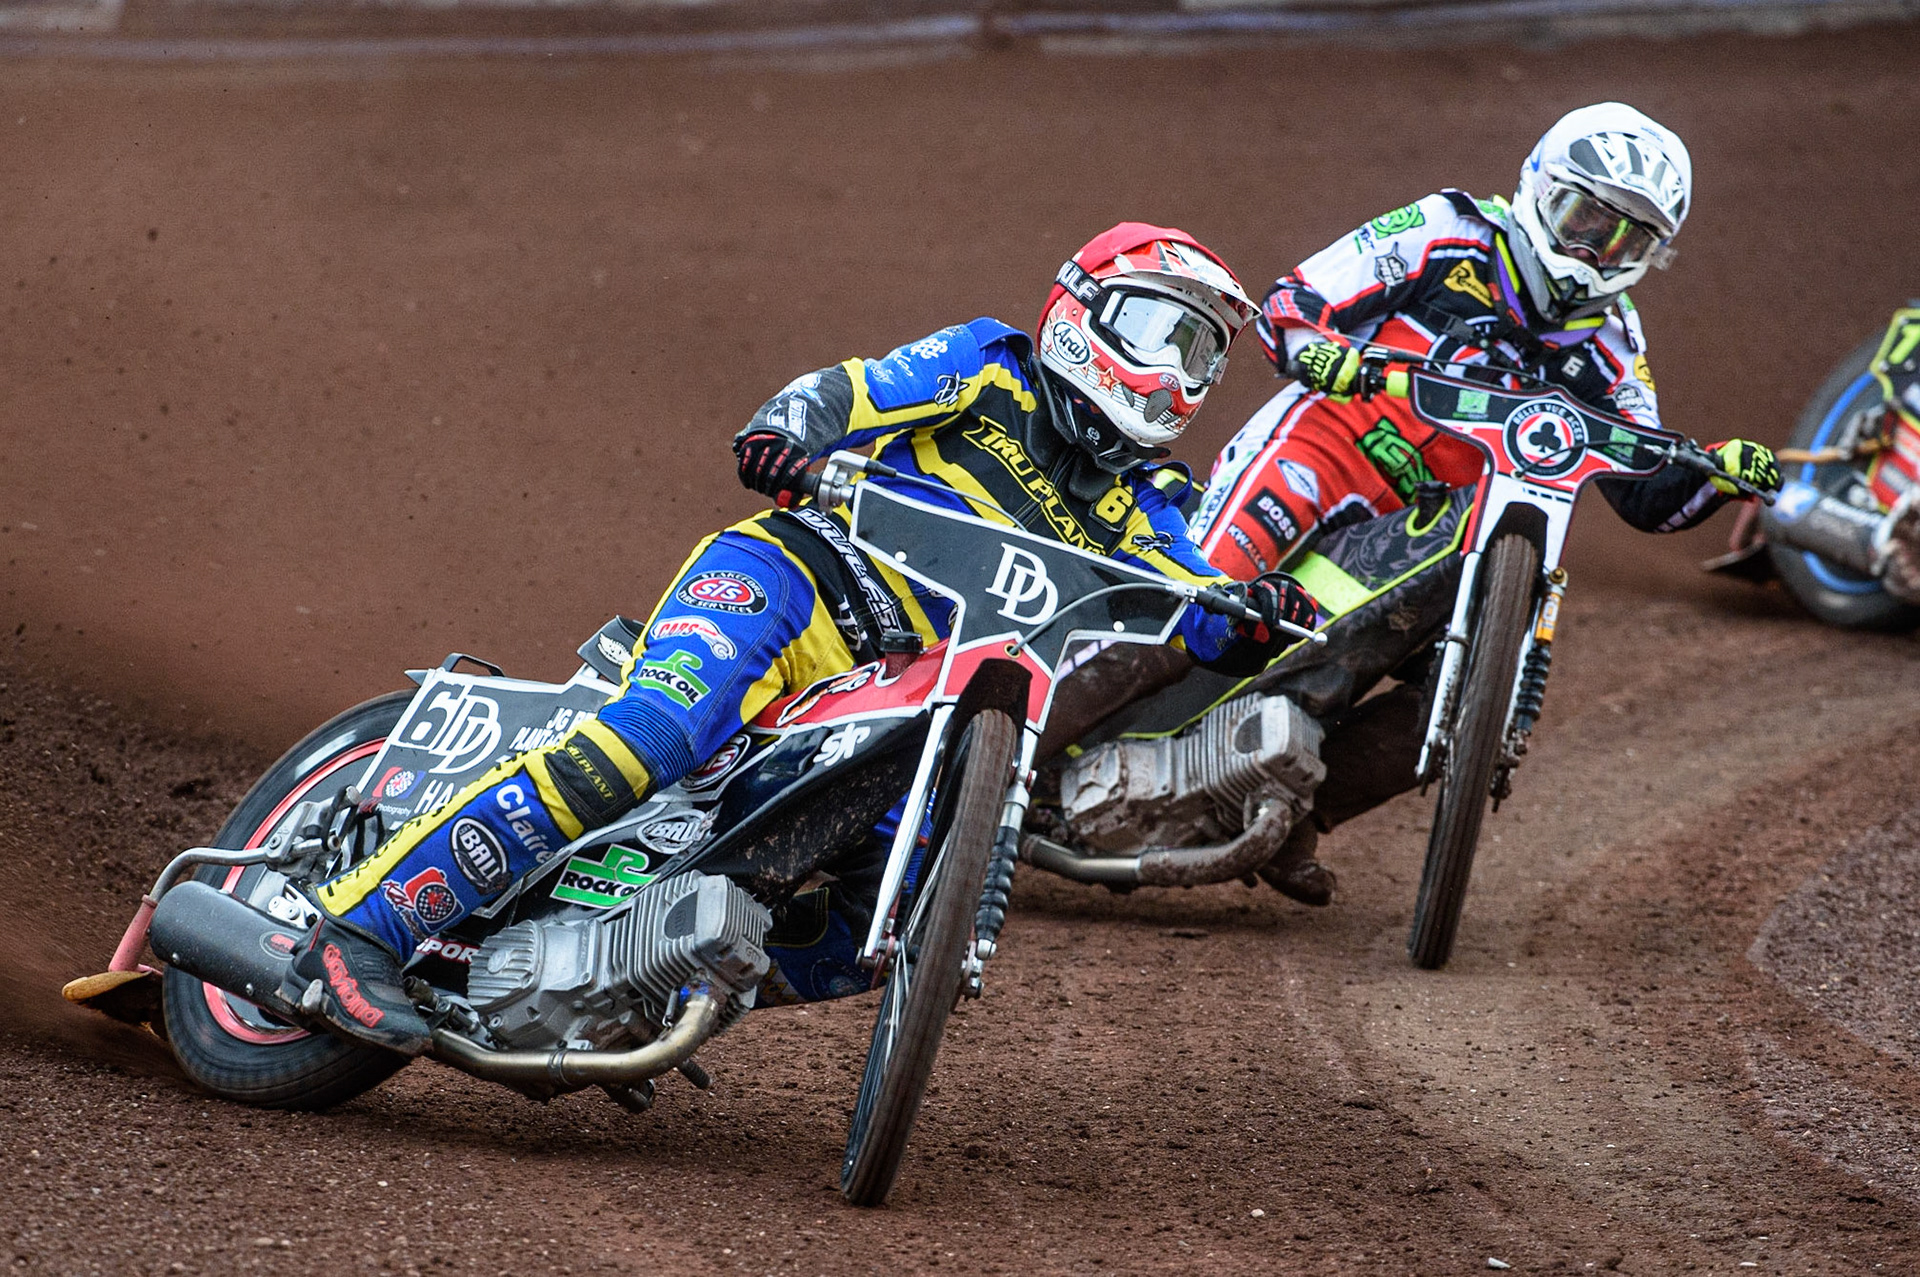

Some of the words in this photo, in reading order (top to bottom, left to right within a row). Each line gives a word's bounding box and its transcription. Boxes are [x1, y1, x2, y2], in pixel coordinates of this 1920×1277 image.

[1054, 328, 1087, 359] Arai
[1513, 403, 1541, 425] BELLE
[1545, 403, 1567, 417] VUE
[1566, 415, 1584, 440] ACES
[980, 427, 1035, 477] TRU
[1027, 477, 1107, 556] PLAN
[1095, 486, 1133, 524] 6
[1257, 495, 1297, 541] BOSS
[696, 580, 743, 601] STS
[697, 600, 753, 614] SERVICES
[638, 668, 678, 685] ROCK
[675, 680, 699, 705] OIL
[577, 759, 615, 800] PLANT
[375, 802, 412, 817] Photography
[496, 784, 556, 864] Claire
[460, 828, 501, 882] BALL
[560, 871, 622, 897] ROCK
